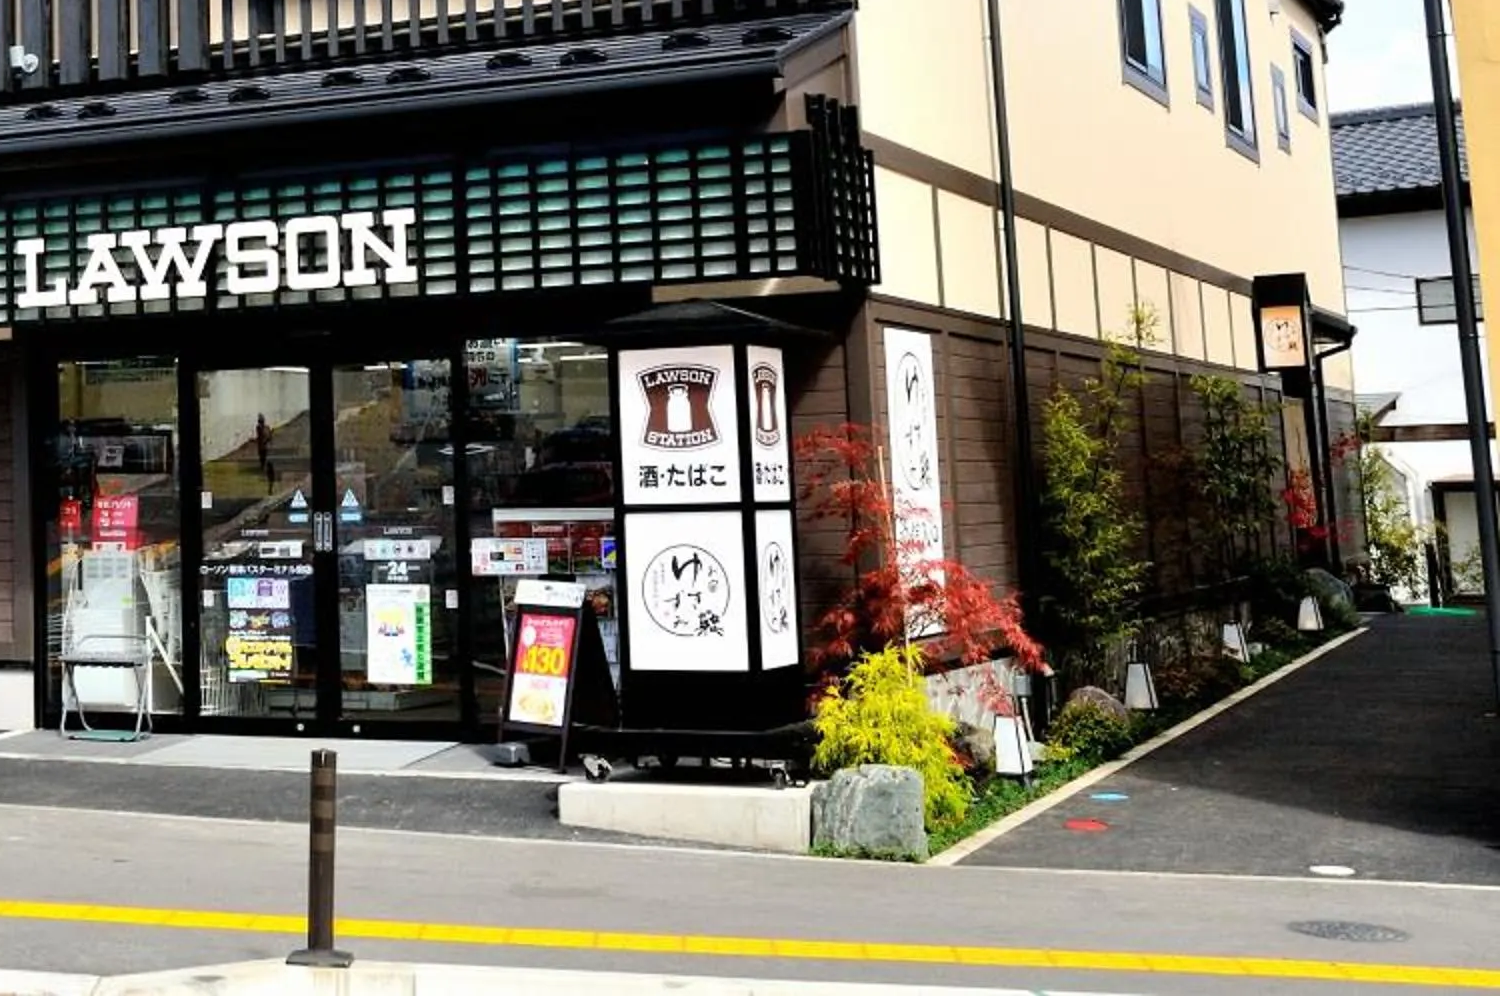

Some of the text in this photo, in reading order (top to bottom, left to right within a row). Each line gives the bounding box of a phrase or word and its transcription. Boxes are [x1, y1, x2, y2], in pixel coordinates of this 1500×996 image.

[13, 207, 420, 309] LAWSON
[643, 369, 712, 388] LAWSON
[648, 428, 713, 446] STATION
[639, 463, 727, 489] 酒・たばこ
[387, 560, 408, 575] 24
